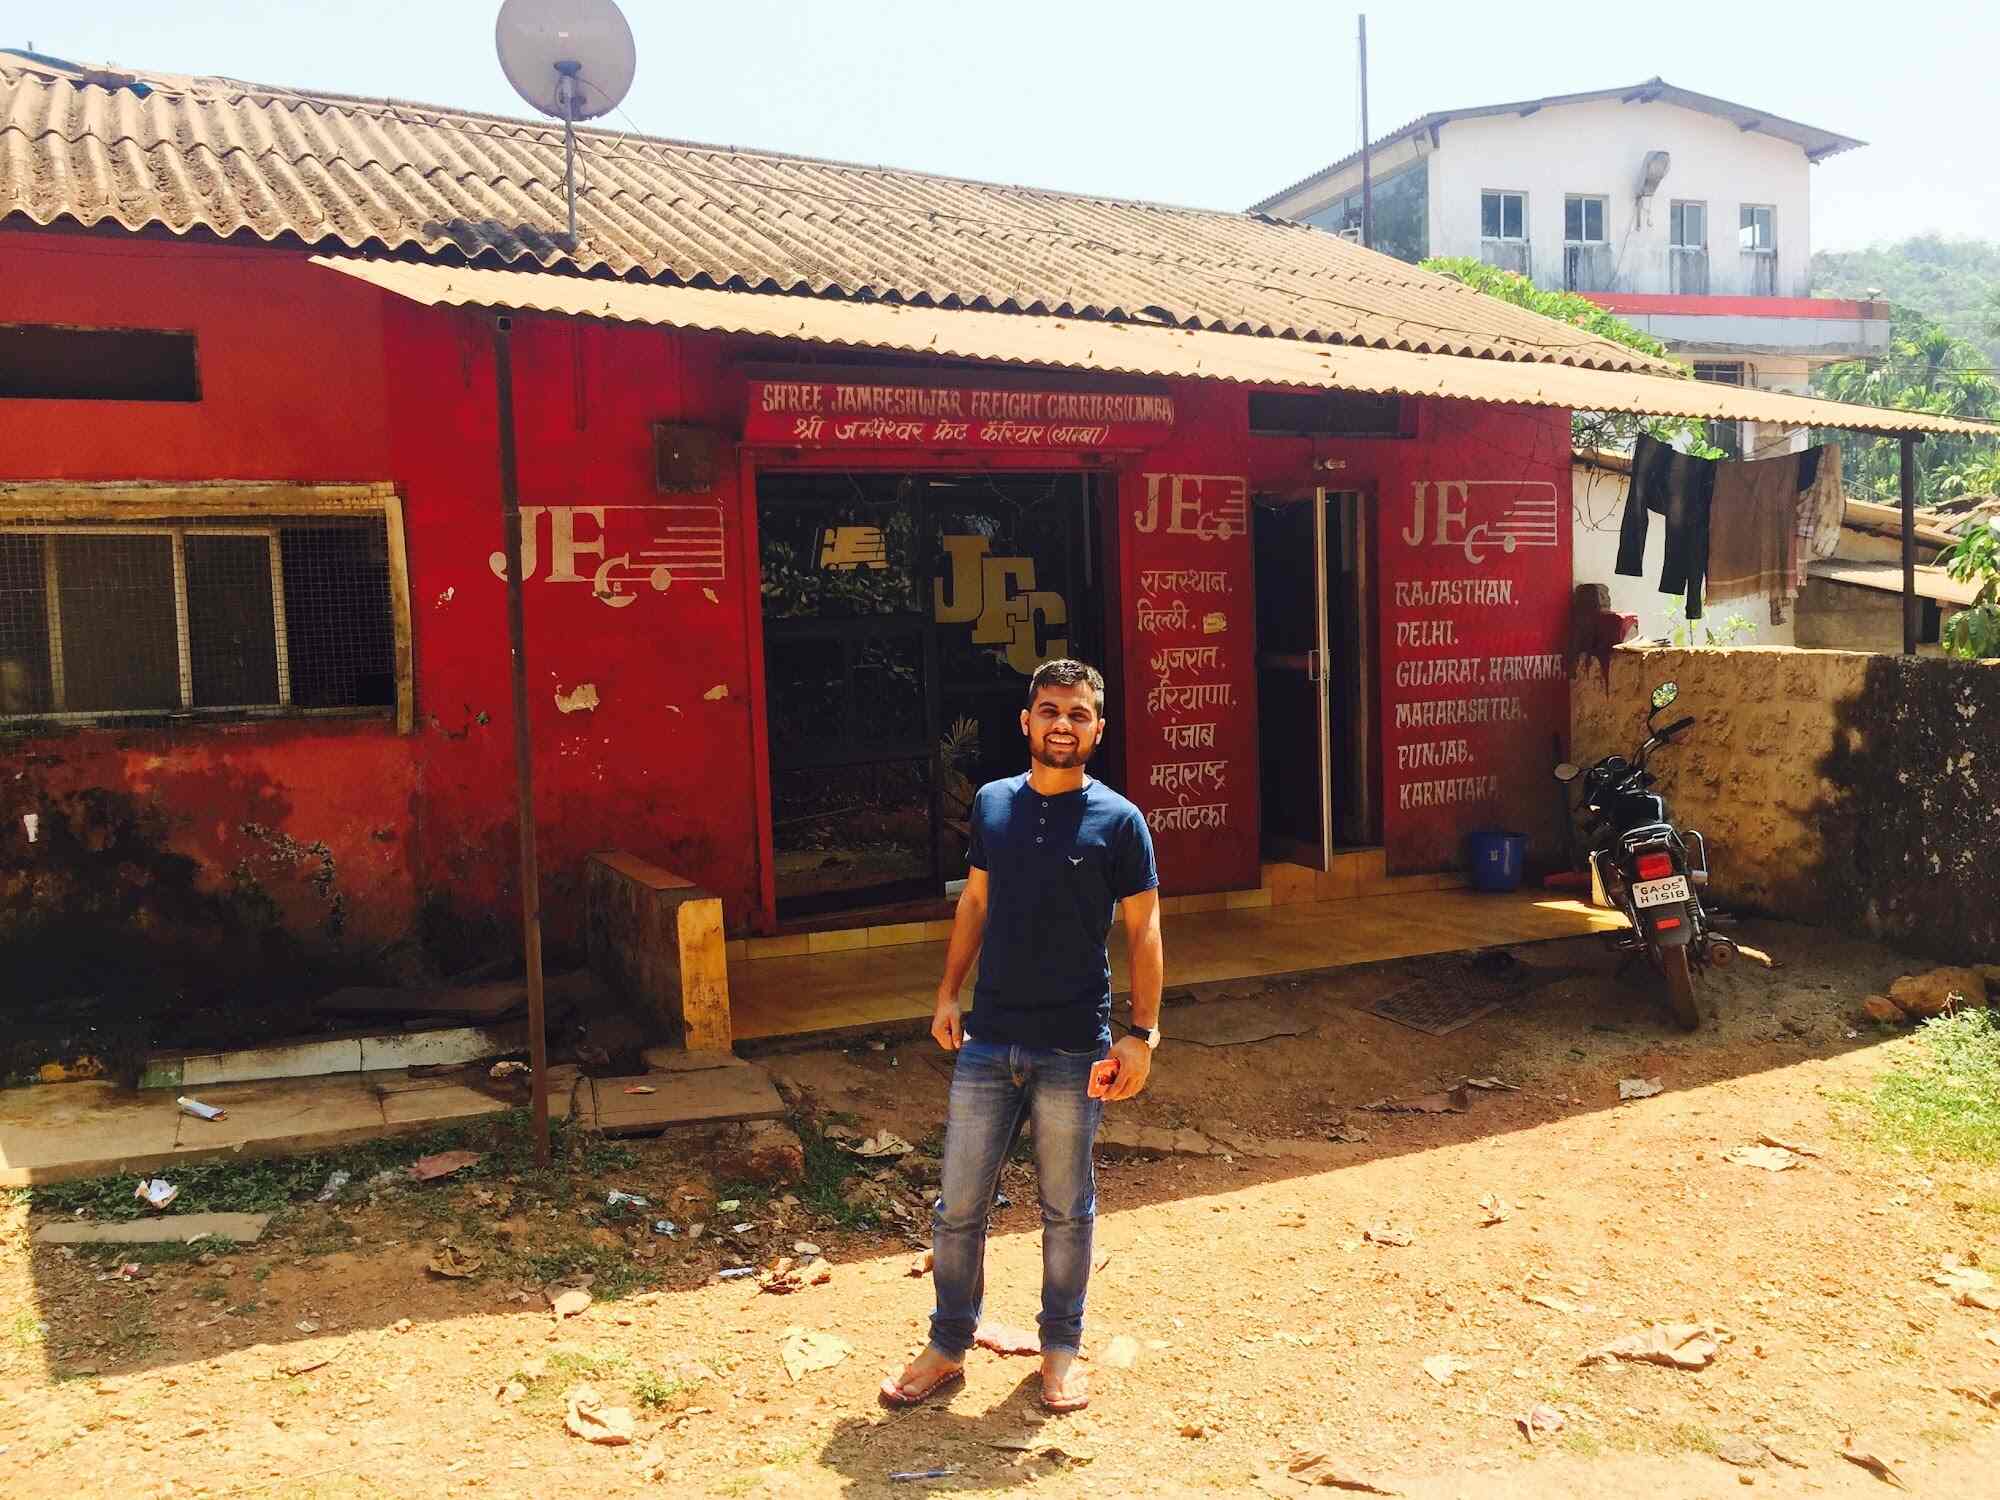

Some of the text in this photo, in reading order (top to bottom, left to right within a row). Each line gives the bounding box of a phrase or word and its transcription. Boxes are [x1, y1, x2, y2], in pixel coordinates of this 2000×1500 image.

[762, 384, 824, 413] SHREE
[831, 386, 964, 418] JAMBESHWAR
[971, 390, 1042, 419] FREIGHT
[793, 415, 829, 440] श्री
[1395, 580, 1520, 607] RAJASTHAN.
[1397, 620, 1459, 647] DELHI.
[1396, 654, 1567, 687] GUJARAT, HARYANA.
[1395, 697, 1528, 729] MAHARASHTRA.
[1162, 717, 1217, 751] पंजाब
[1397, 740, 1474, 770] PUNJAB.
[1640, 882, 1681, 895] GA-05
